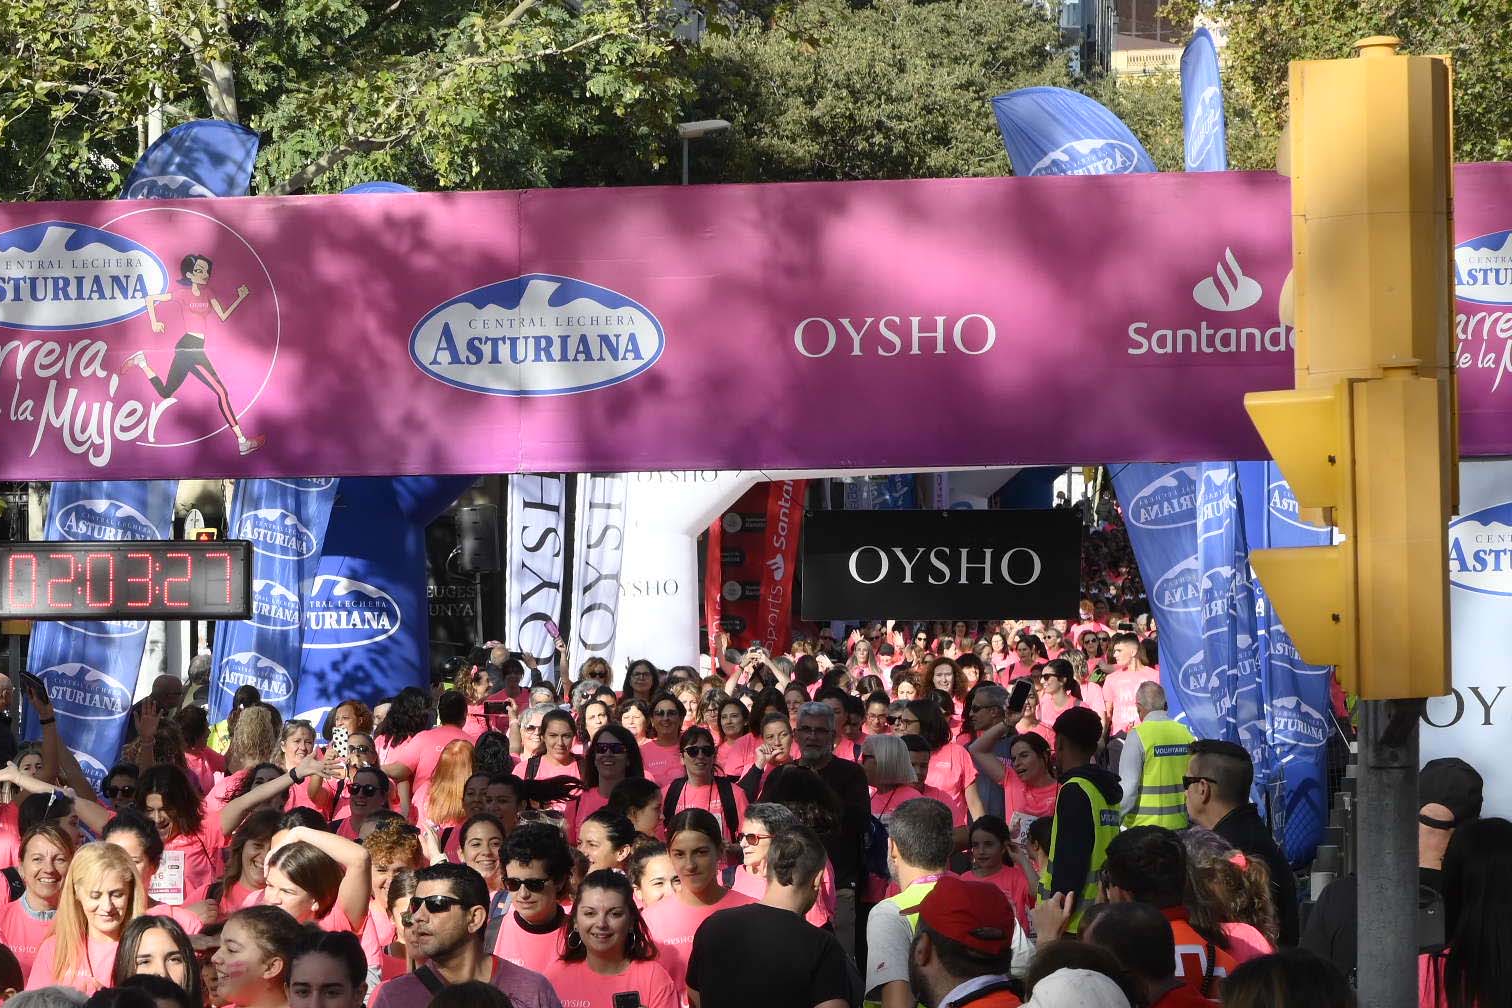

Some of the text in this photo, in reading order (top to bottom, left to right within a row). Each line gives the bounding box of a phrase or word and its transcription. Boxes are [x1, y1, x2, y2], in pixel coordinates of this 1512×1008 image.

[72, 257, 145, 269] LECHERA
[1469, 257, 1512, 265] CENTRA
[468, 315, 637, 330] CENTRAL LECHERA
[794, 313, 997, 358] OYSHO
[1127, 318, 1295, 356] Santand
[428, 321, 645, 366] ASTURIANA
[9, 383, 35, 422] la
[29, 373, 179, 467] Mujer
[239, 519, 307, 554] ASTURIANA
[518, 473, 561, 665] OYSH
[579, 473, 622, 651] OYSH
[848, 545, 1043, 586] OYSHO
[8, 553, 232, 608] 02:03:27
[253, 601, 300, 623] URIANA
[310, 600, 333, 608] TRAL
[220, 667, 287, 695] ASTURIANA
[1273, 714, 1324, 741] STURIANA
